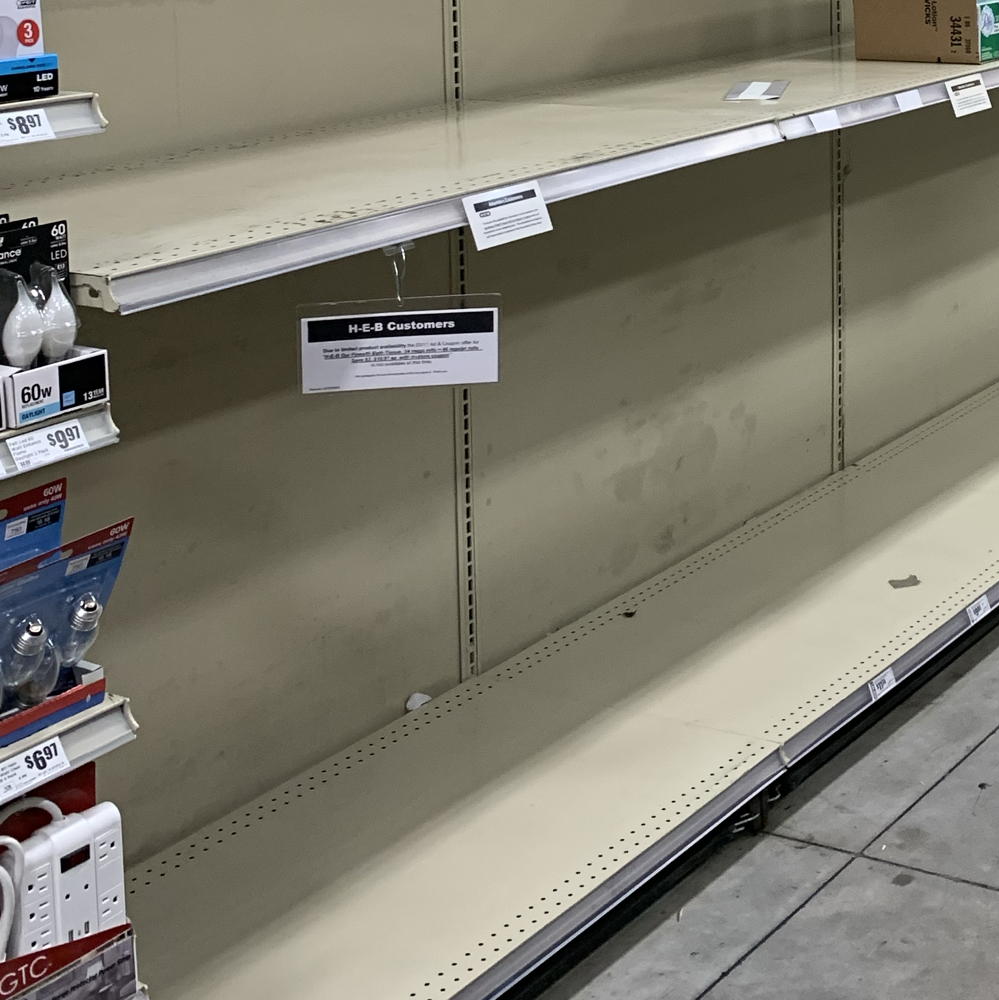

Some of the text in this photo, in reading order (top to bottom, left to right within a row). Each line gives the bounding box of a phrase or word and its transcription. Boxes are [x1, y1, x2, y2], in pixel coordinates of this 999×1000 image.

[24, 22, 33, 38] 3
[950, 16, 962, 47] 34431
[36, 73, 53, 82] LED
[50, 224, 66, 236] 60
[0, 249, 21, 260] ance
[50, 249, 67, 260] LED
[348, 320, 456, 333] H-E-B Customers
[83, 392, 92, 401] 13
[22, 408, 46, 420] DAYLIGHT
[43, 483, 63, 497] 60W
[99, 963, 116, 976] Power
[0, 956, 47, 996] GTC
